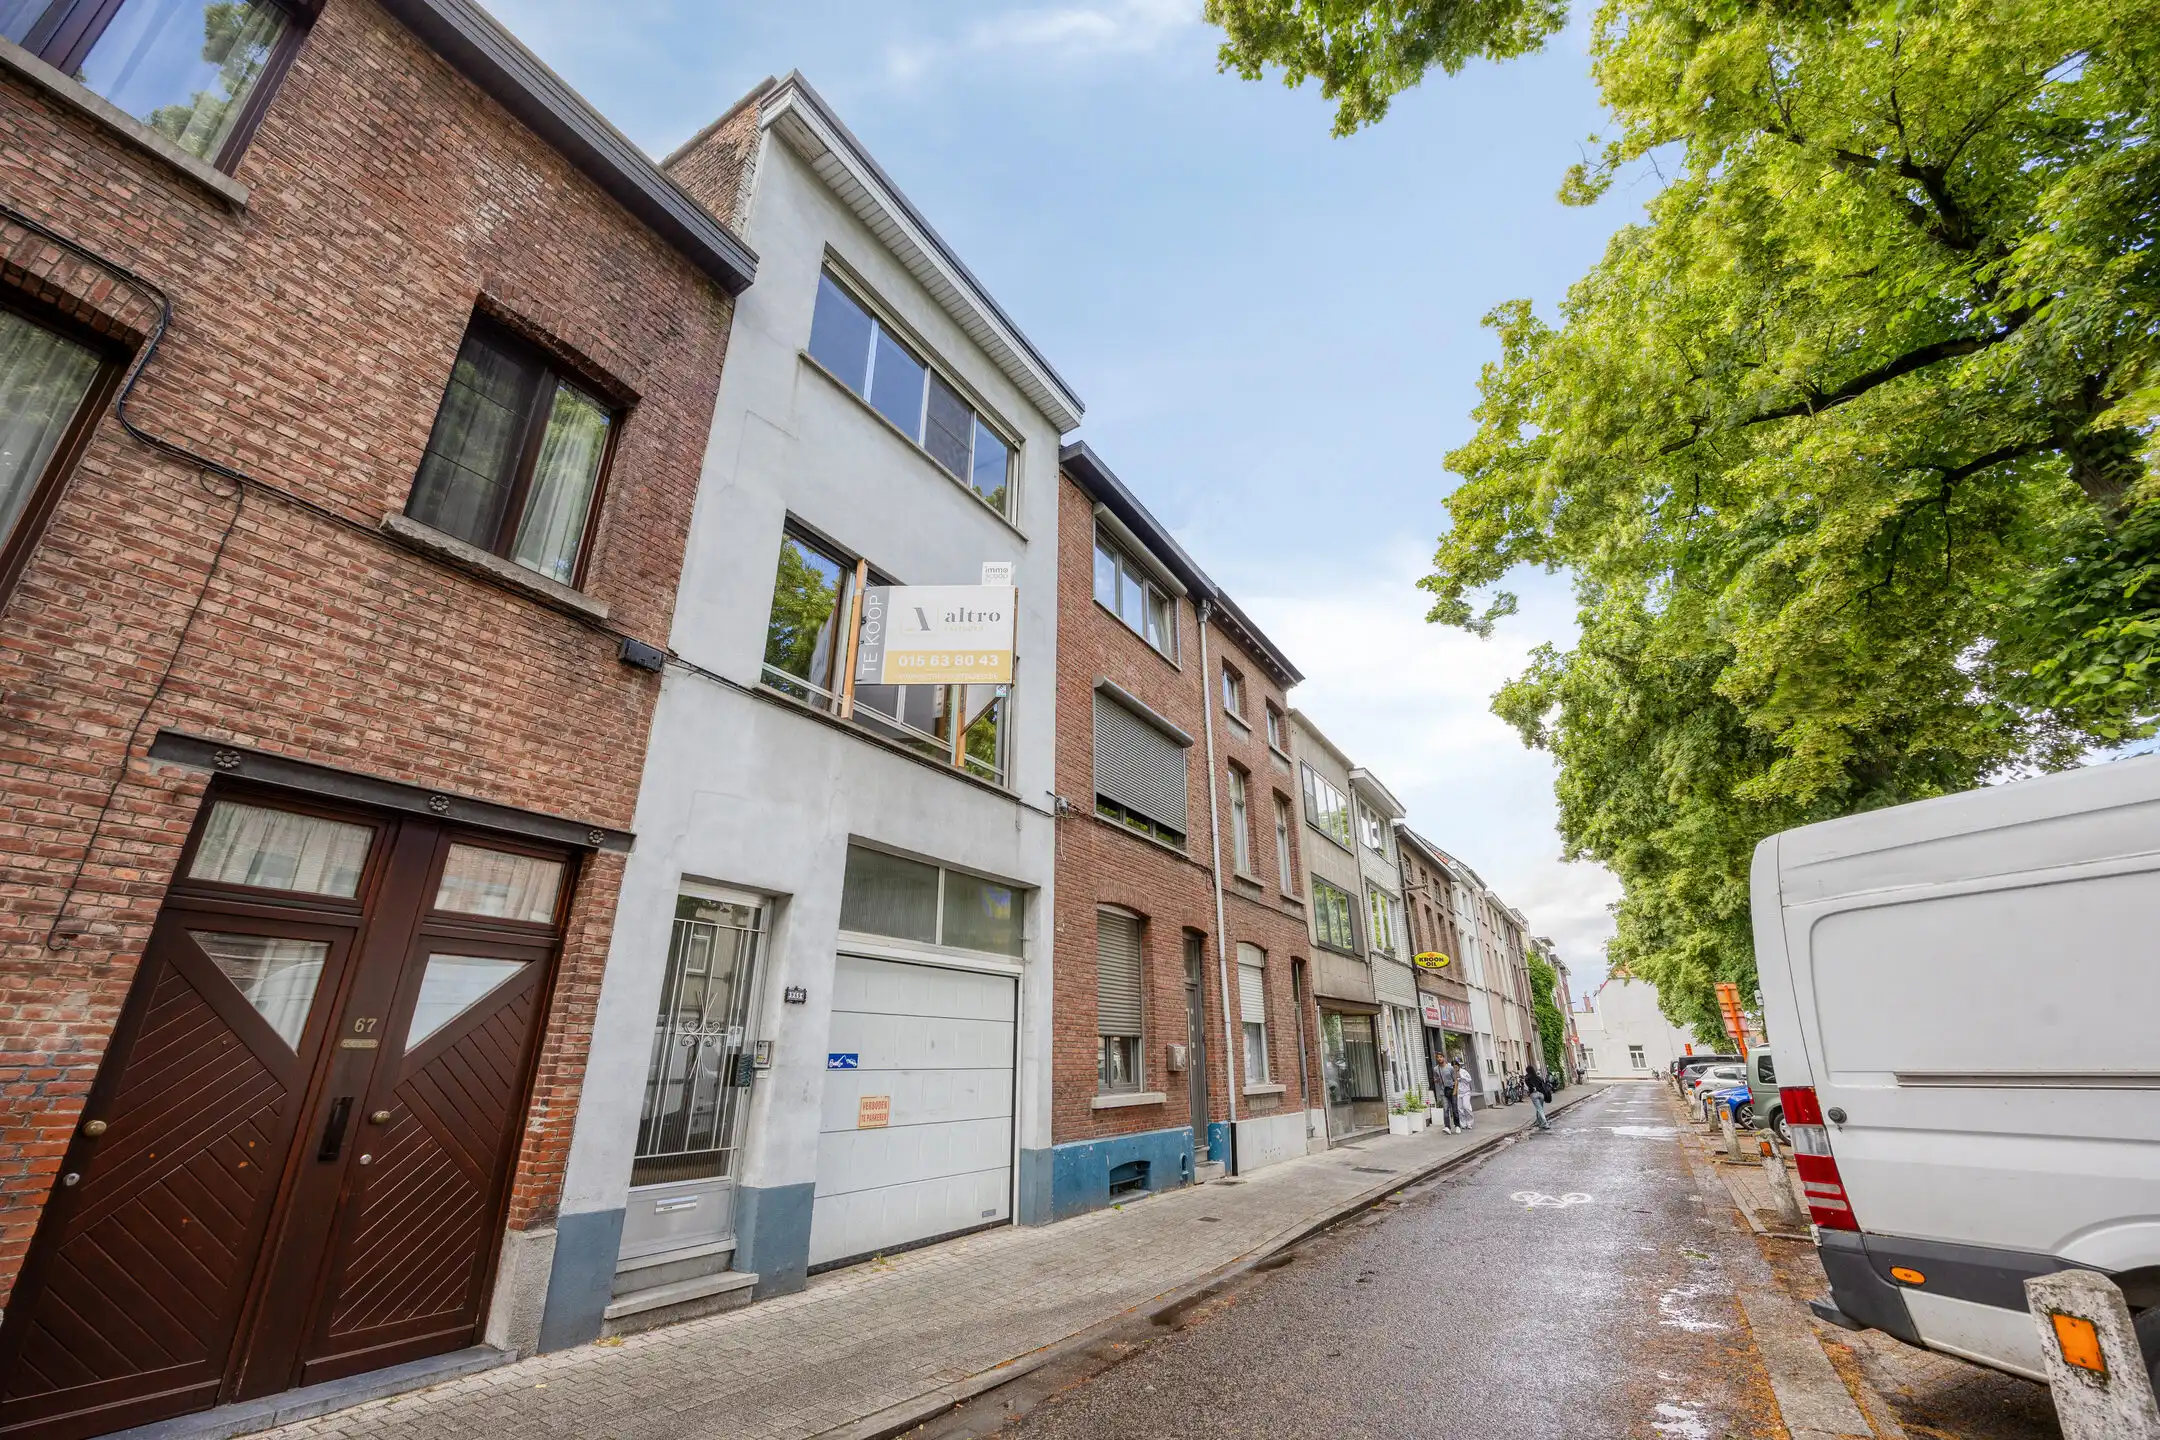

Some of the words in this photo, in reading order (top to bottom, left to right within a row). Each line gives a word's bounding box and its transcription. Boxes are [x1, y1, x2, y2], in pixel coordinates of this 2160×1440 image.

[864, 595, 883, 646] KOOP
[944, 607, 1001, 623] altro
[861, 652, 878, 676] TE
[898, 654, 926, 667] 015
[930, 654, 950, 667] 63
[954, 654, 975, 667] 80
[978, 654, 999, 667] 43
[354, 1017, 378, 1033] 67
